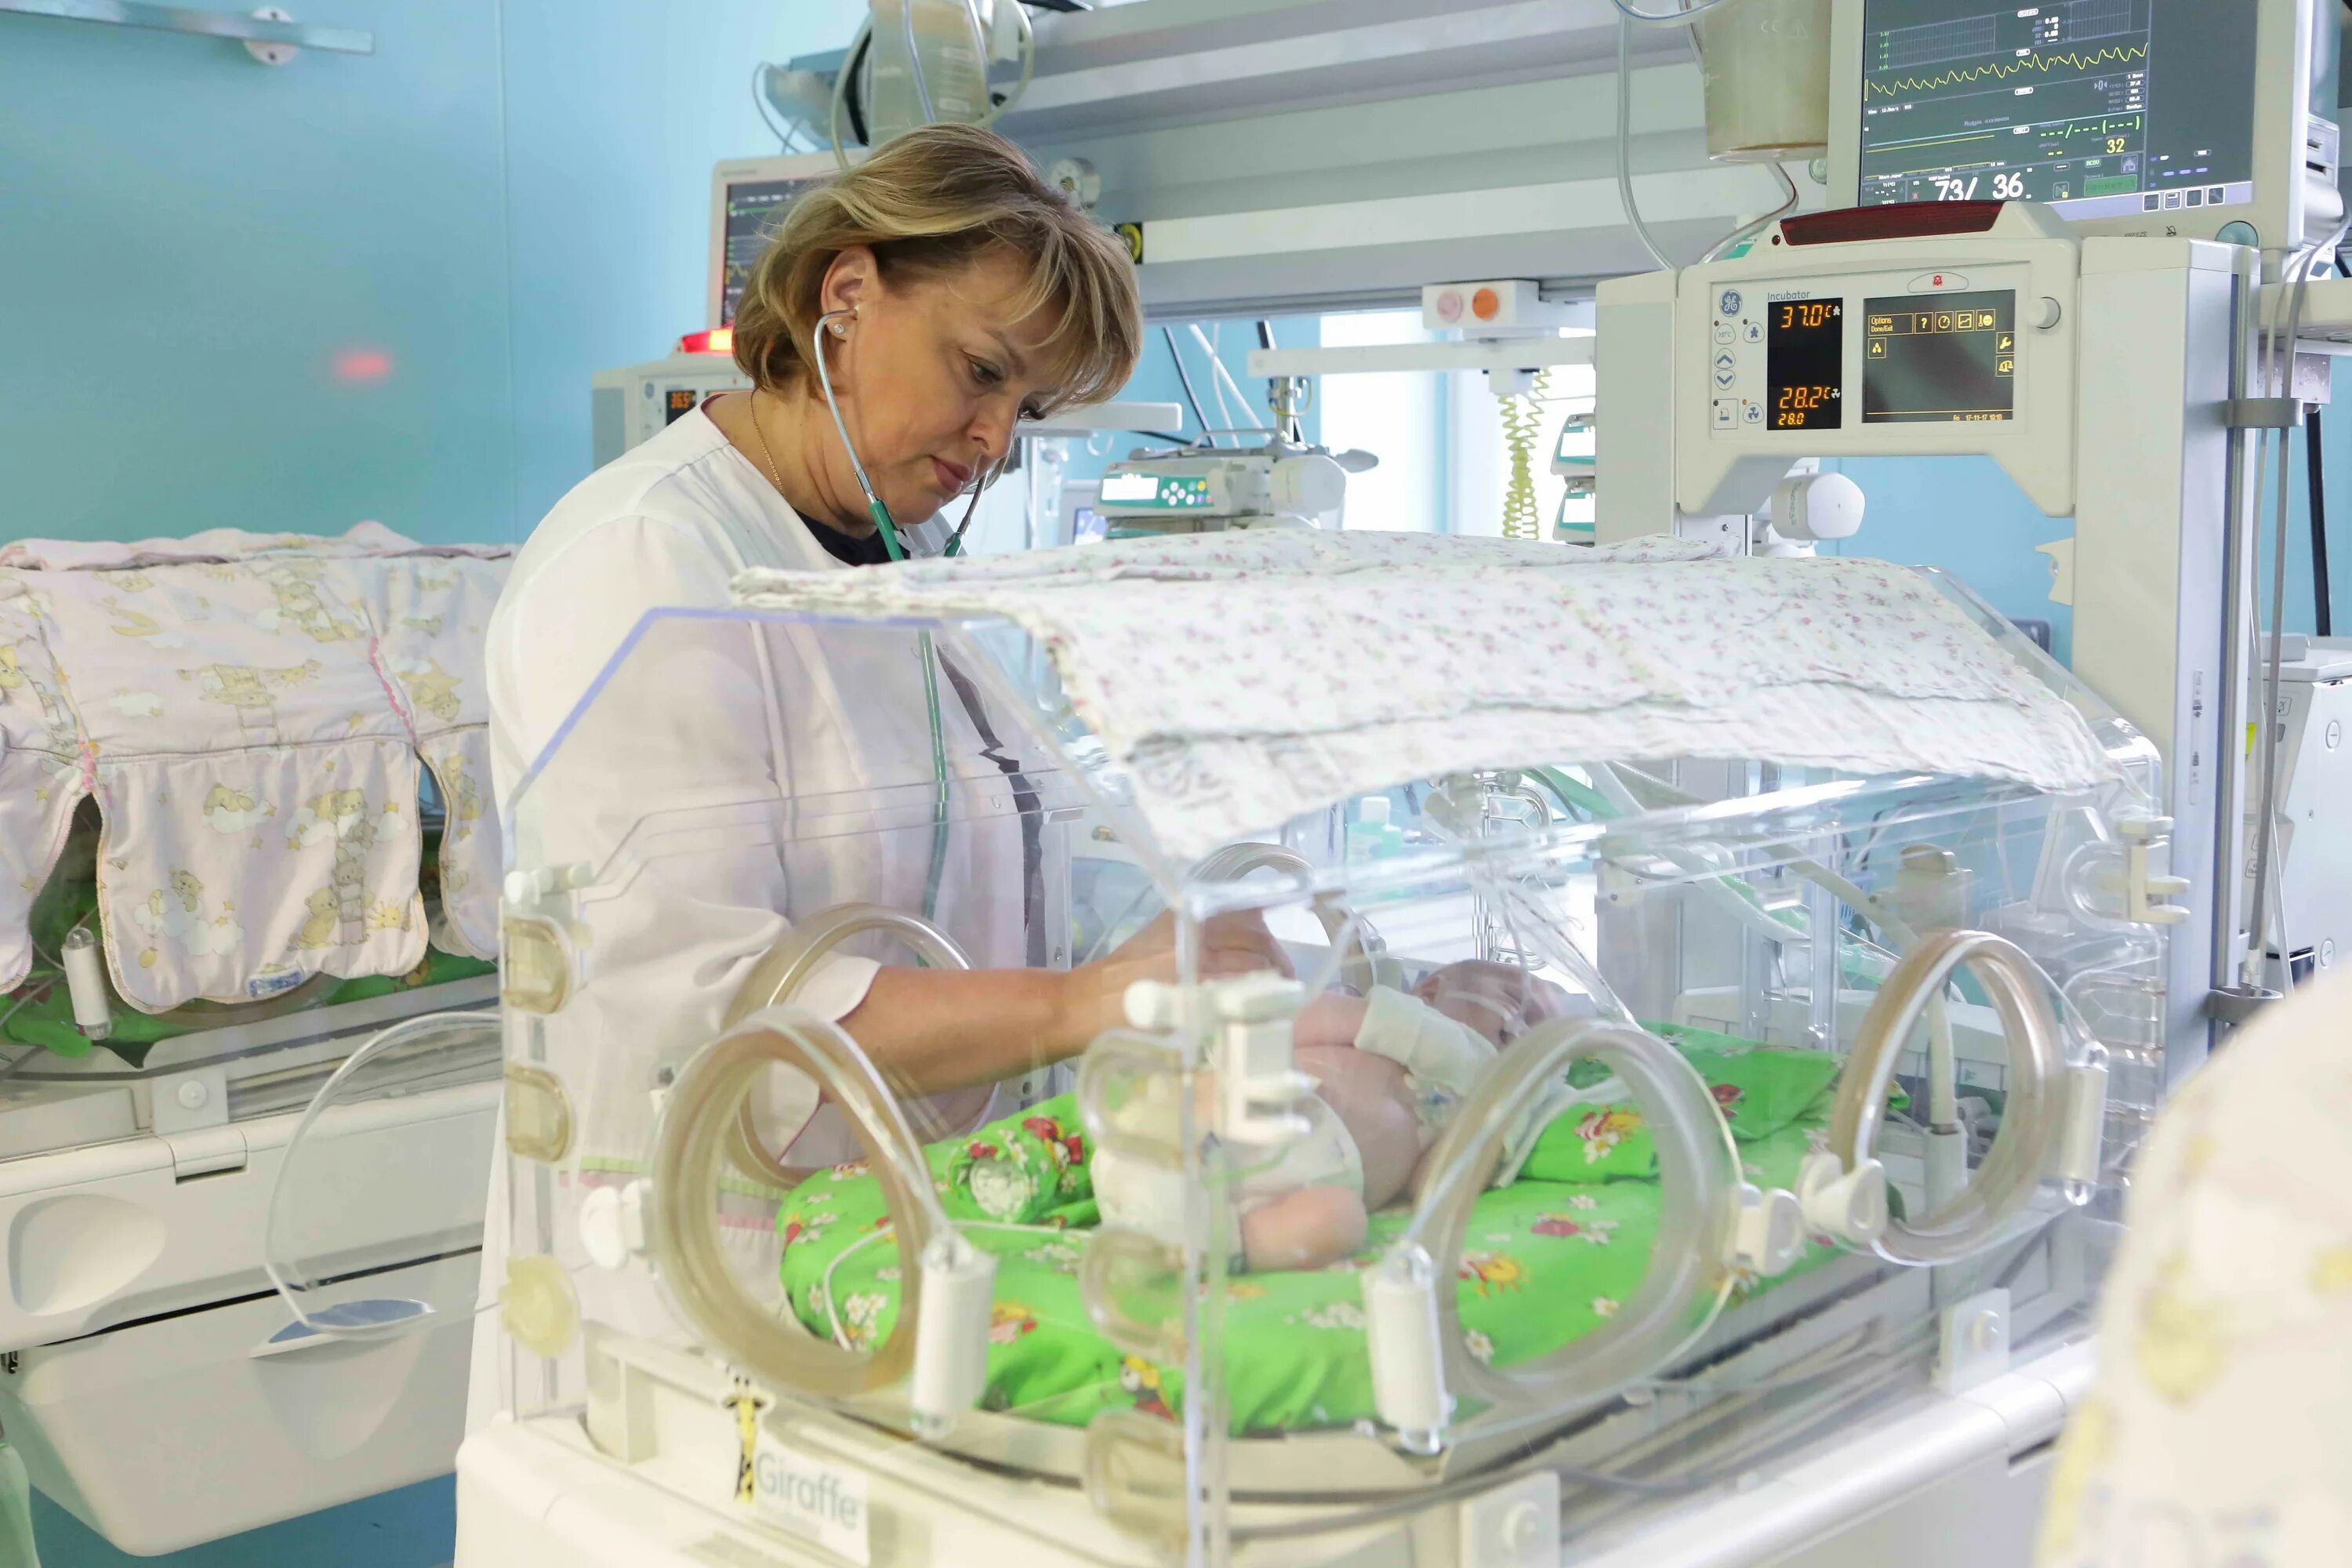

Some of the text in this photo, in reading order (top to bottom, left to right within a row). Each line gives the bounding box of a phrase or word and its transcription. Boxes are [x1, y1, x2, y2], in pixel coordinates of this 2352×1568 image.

[2107, 138, 2125, 154] 32
[1992, 172, 2024, 199] 36
[1768, 291, 1811, 301] Incubator
[1871, 317, 1892, 325] Options
[1778, 413, 1805, 426] 28.0
[757, 1452, 857, 1531] Giraffe
